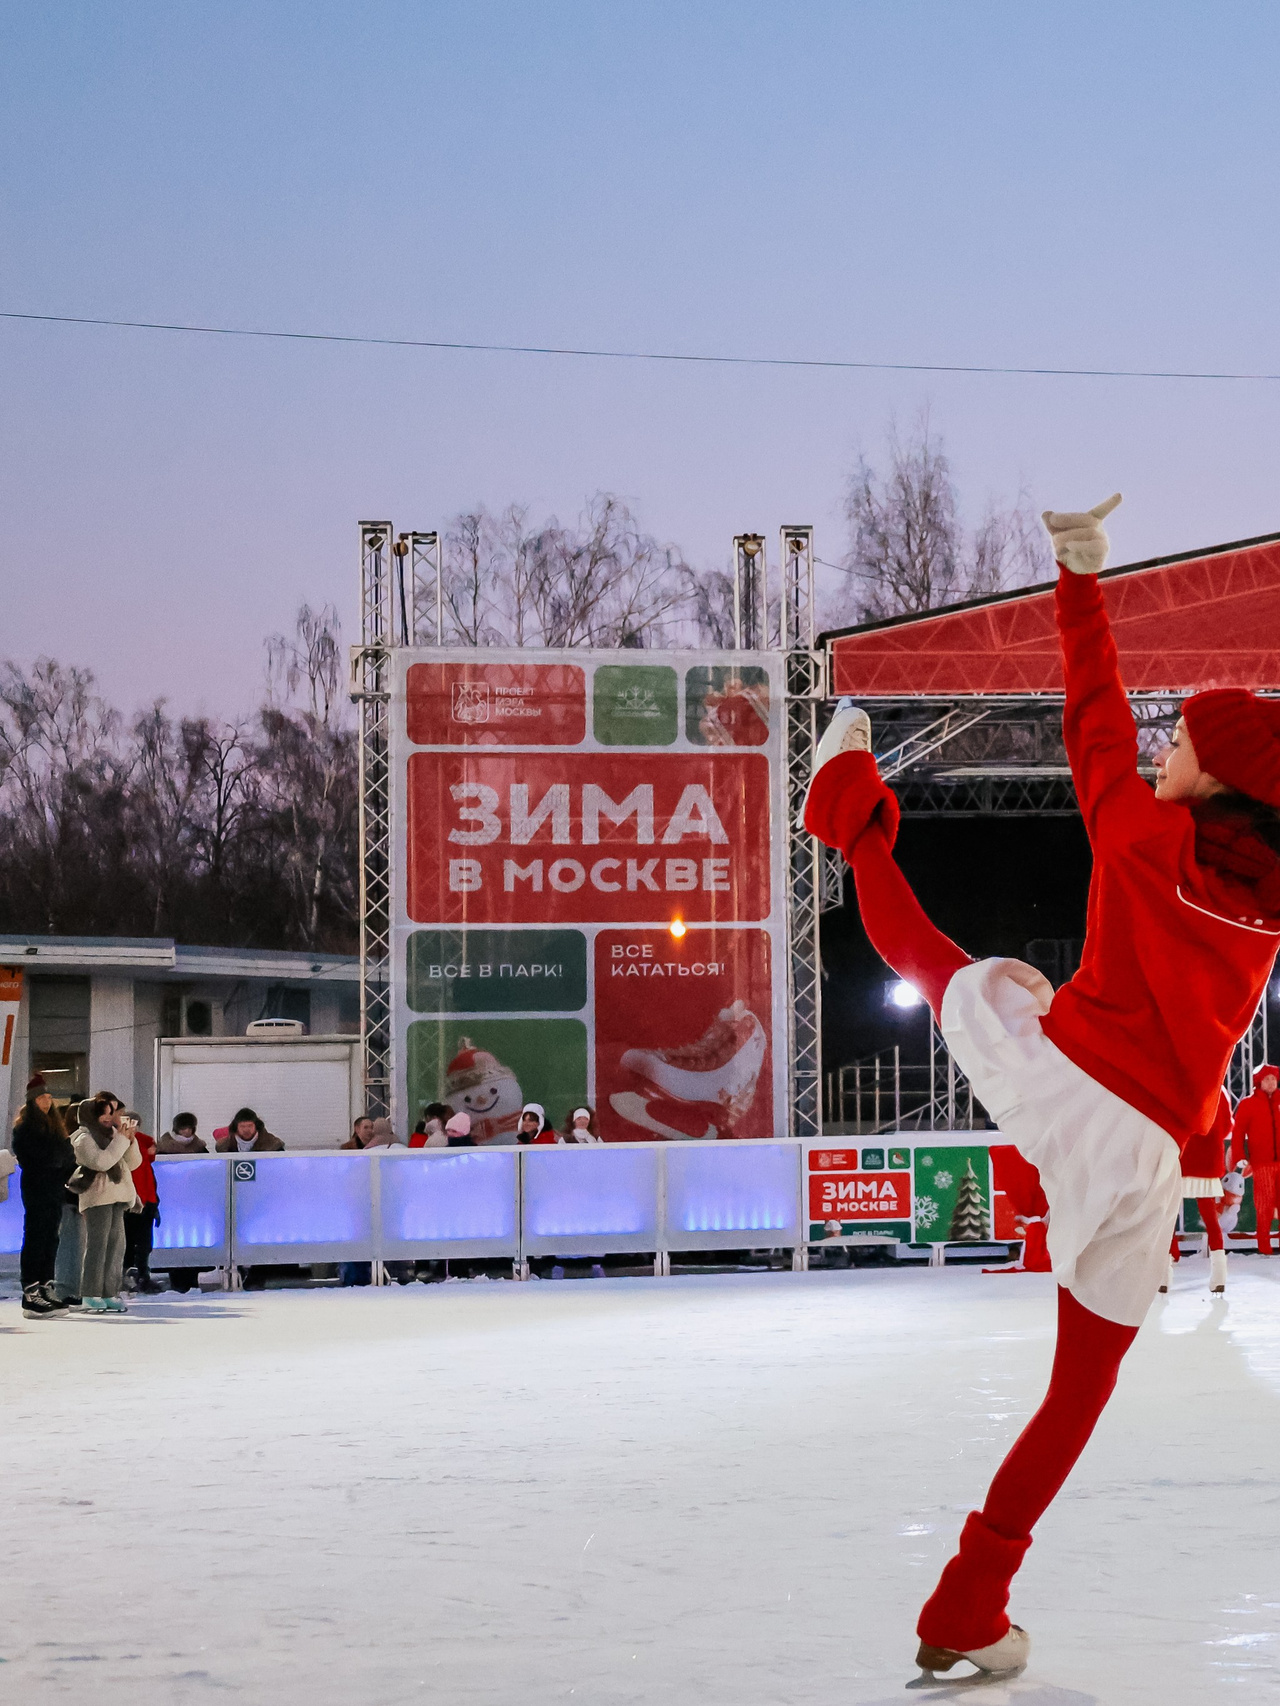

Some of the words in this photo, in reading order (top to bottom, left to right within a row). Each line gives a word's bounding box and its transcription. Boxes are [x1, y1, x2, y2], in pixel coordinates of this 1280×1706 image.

[495, 707, 542, 717] МОСКВЫ
[448, 782, 729, 845] ЗИМА
[449, 858, 483, 892] В
[503, 858, 731, 893] МОСКВЕ
[611, 944, 654, 958] ВСЕ
[429, 965, 471, 978] ВСЕ
[479, 965, 492, 978] В
[500, 964, 563, 978] ПАРК!
[611, 962, 725, 977] КАТАТЬСЯ!
[822, 1180, 898, 1200] ЗИМА
[822, 1202, 833, 1212] В
[836, 1200, 898, 1212] МОСКВЕ
